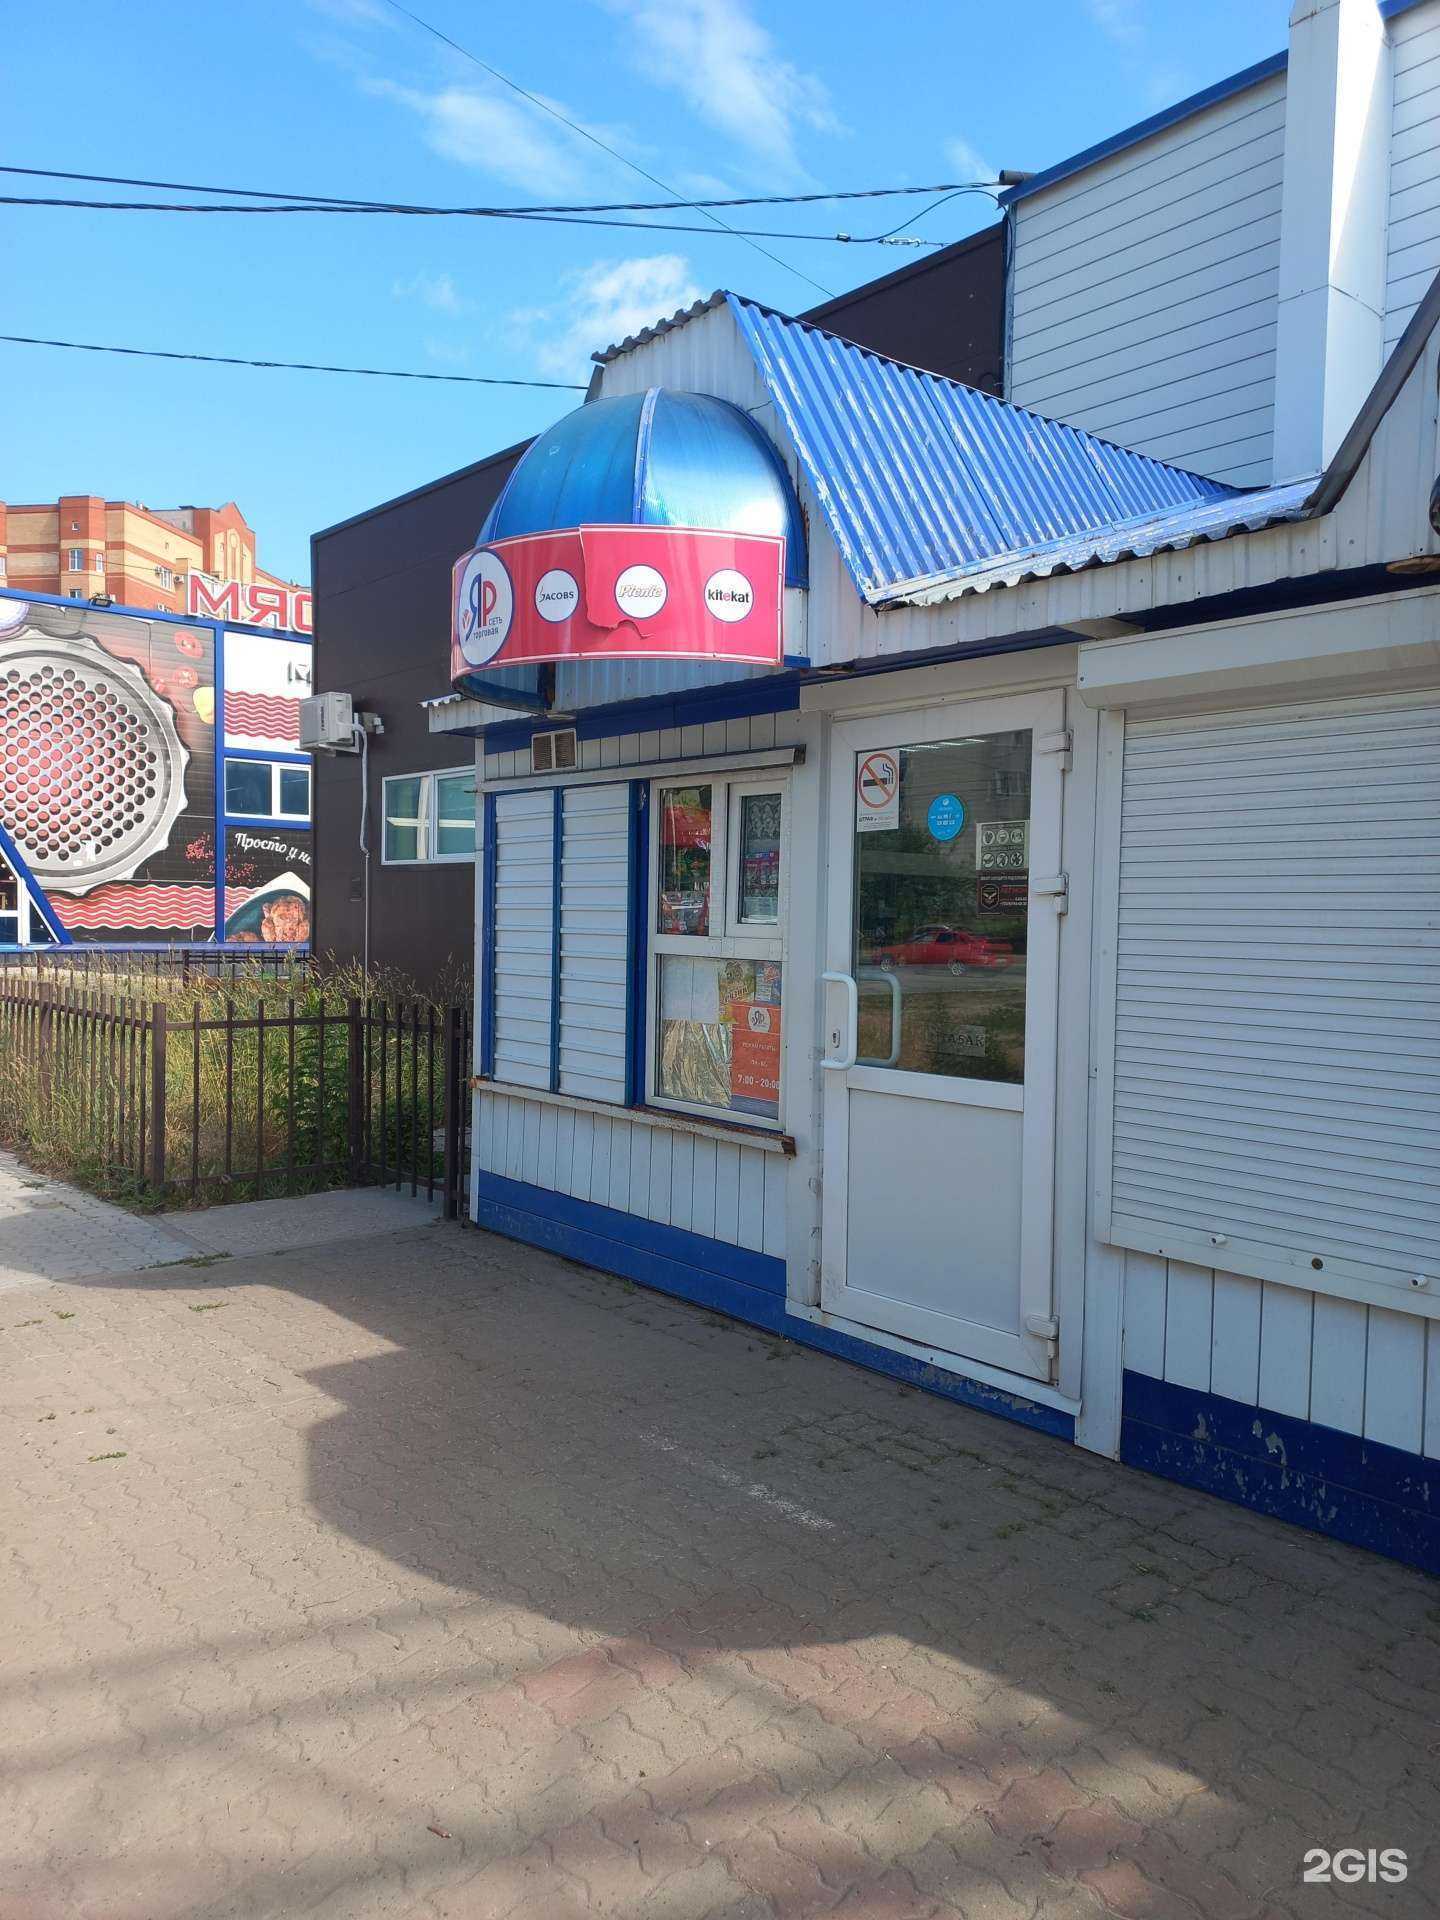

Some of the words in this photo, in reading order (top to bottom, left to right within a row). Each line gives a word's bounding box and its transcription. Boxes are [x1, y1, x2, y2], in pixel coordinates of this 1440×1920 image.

[539, 587, 575, 603] JACOBS
[708, 588, 750, 604] kitekat
[234, 832, 287, 853] Просто
[285, 846, 298, 862] у
[737, 1073, 754, 1086] 7:00
